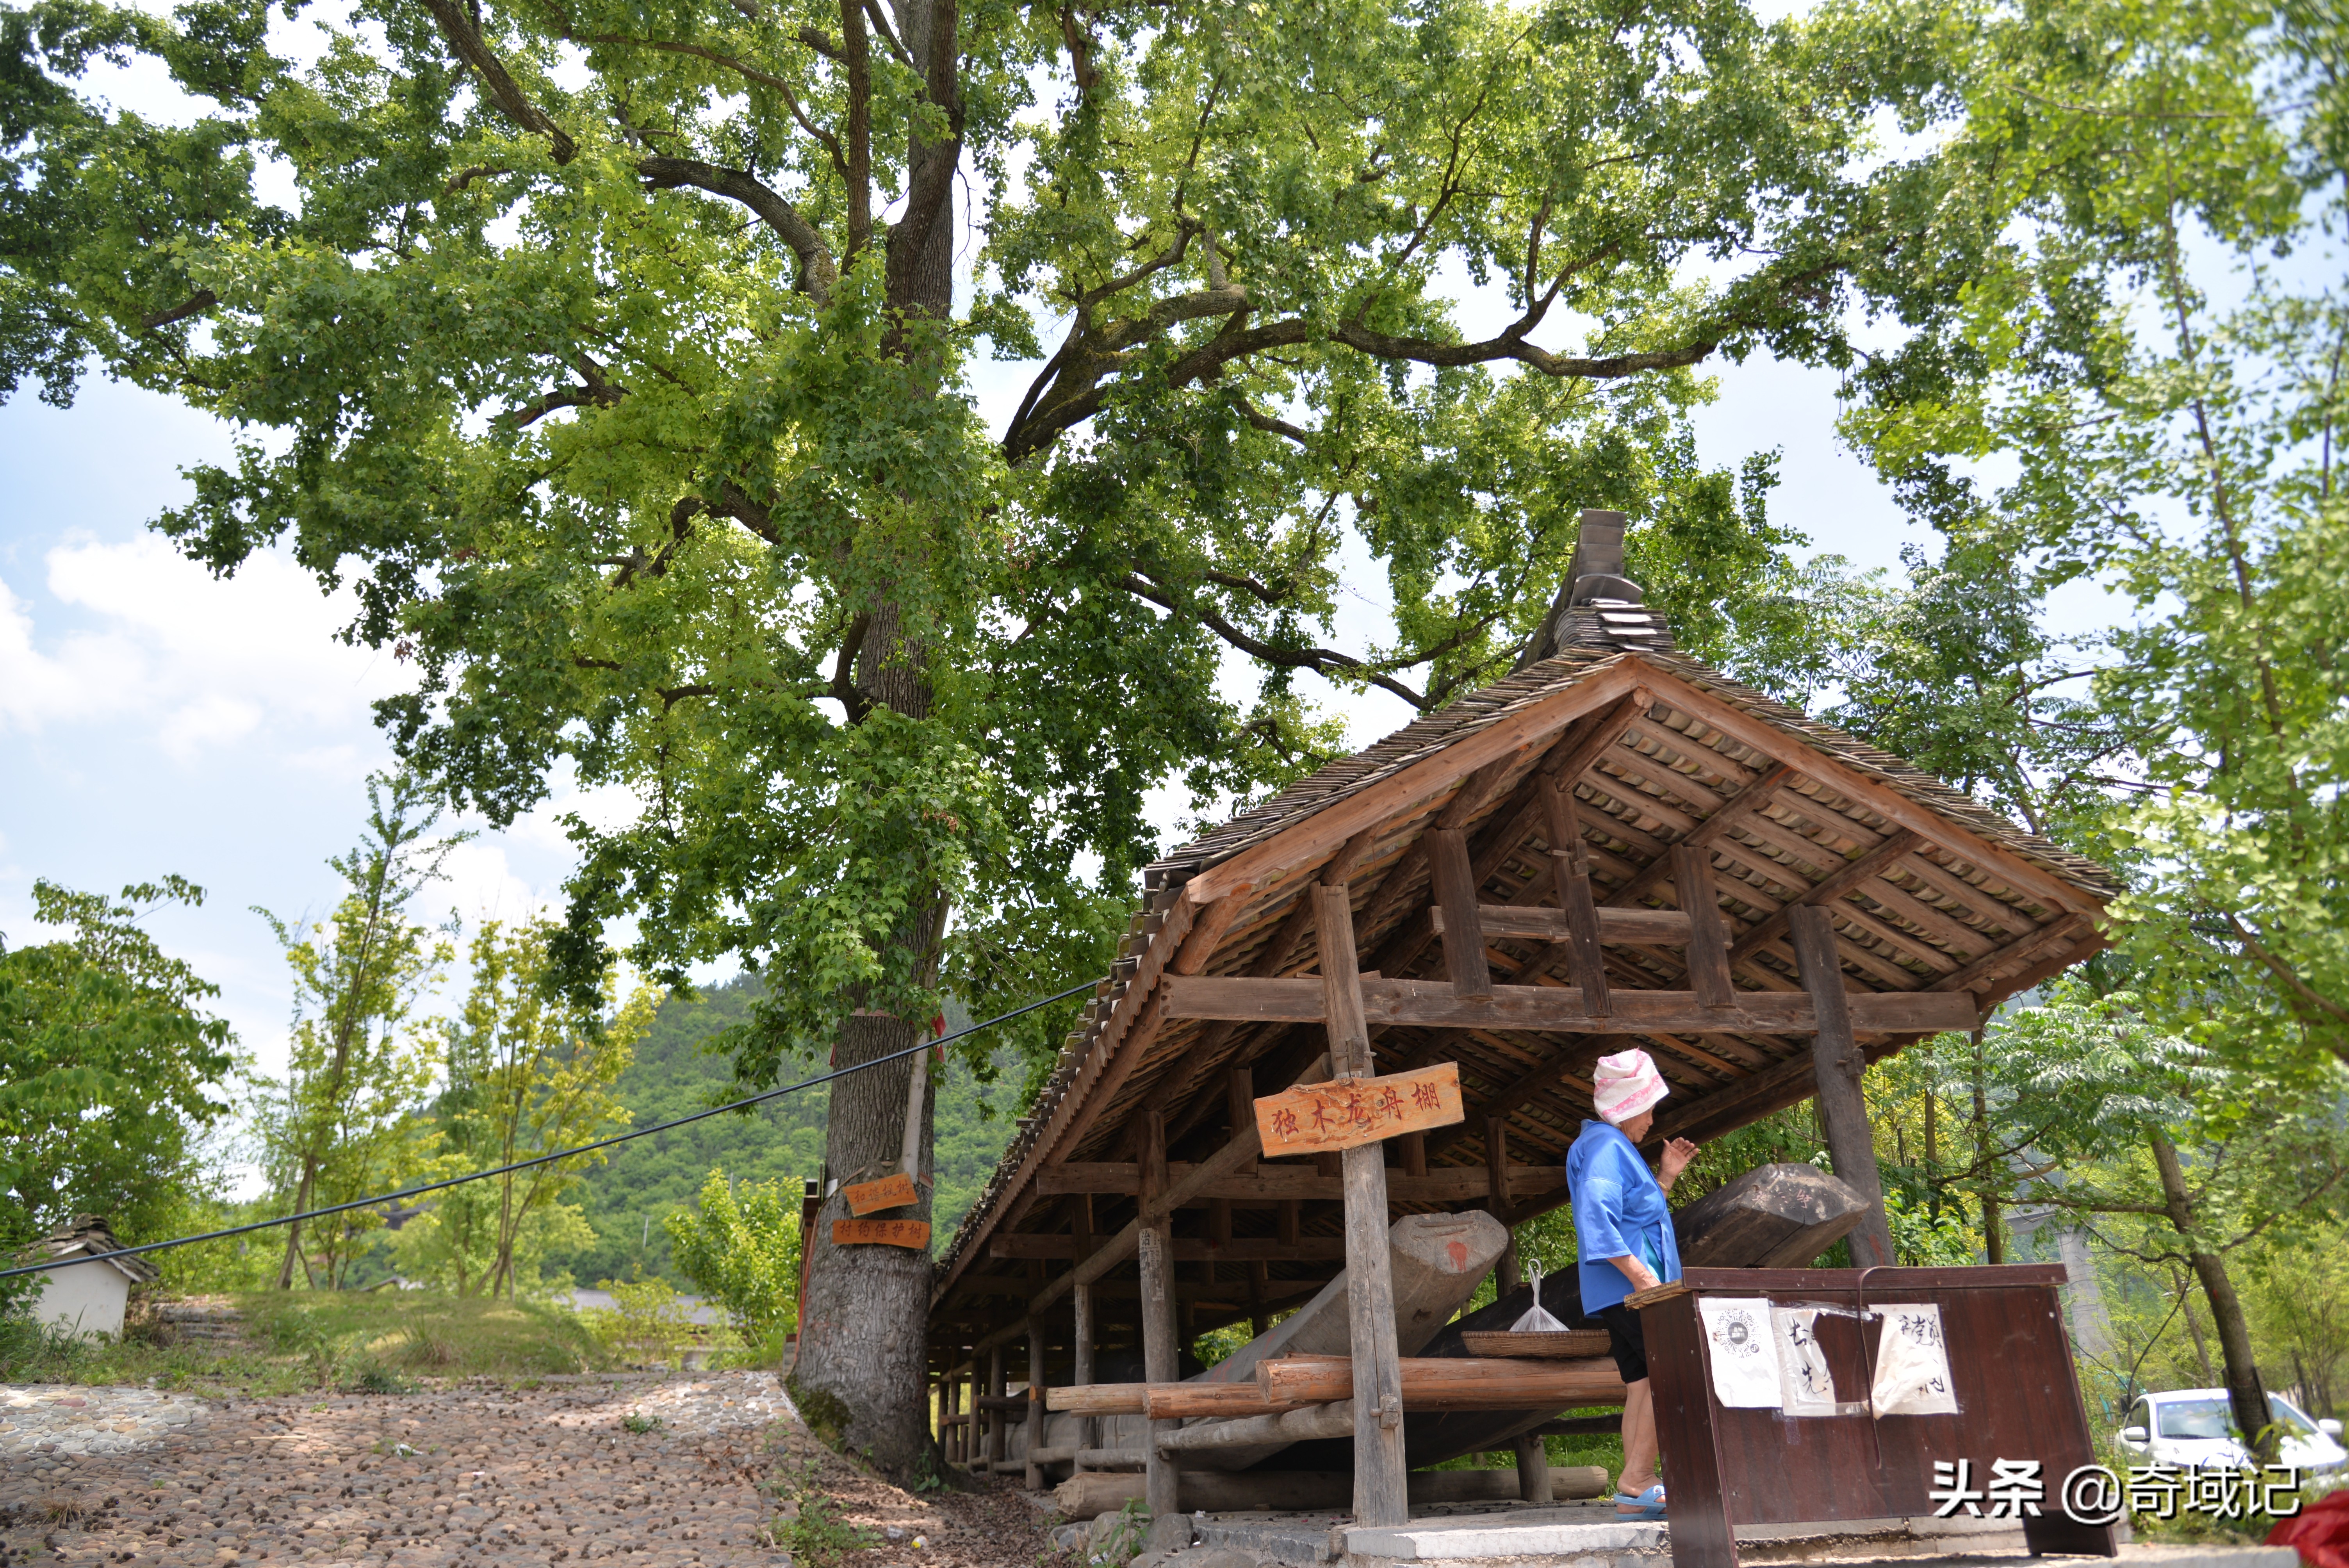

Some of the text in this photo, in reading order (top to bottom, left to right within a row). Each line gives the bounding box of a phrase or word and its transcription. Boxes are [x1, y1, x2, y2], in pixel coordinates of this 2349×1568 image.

[1271, 1082, 1441, 1139] 独木龙舟棚
[855, 1179, 909, 1202] 和谐枫树
[839, 1221, 921, 1240] 村约保护树
